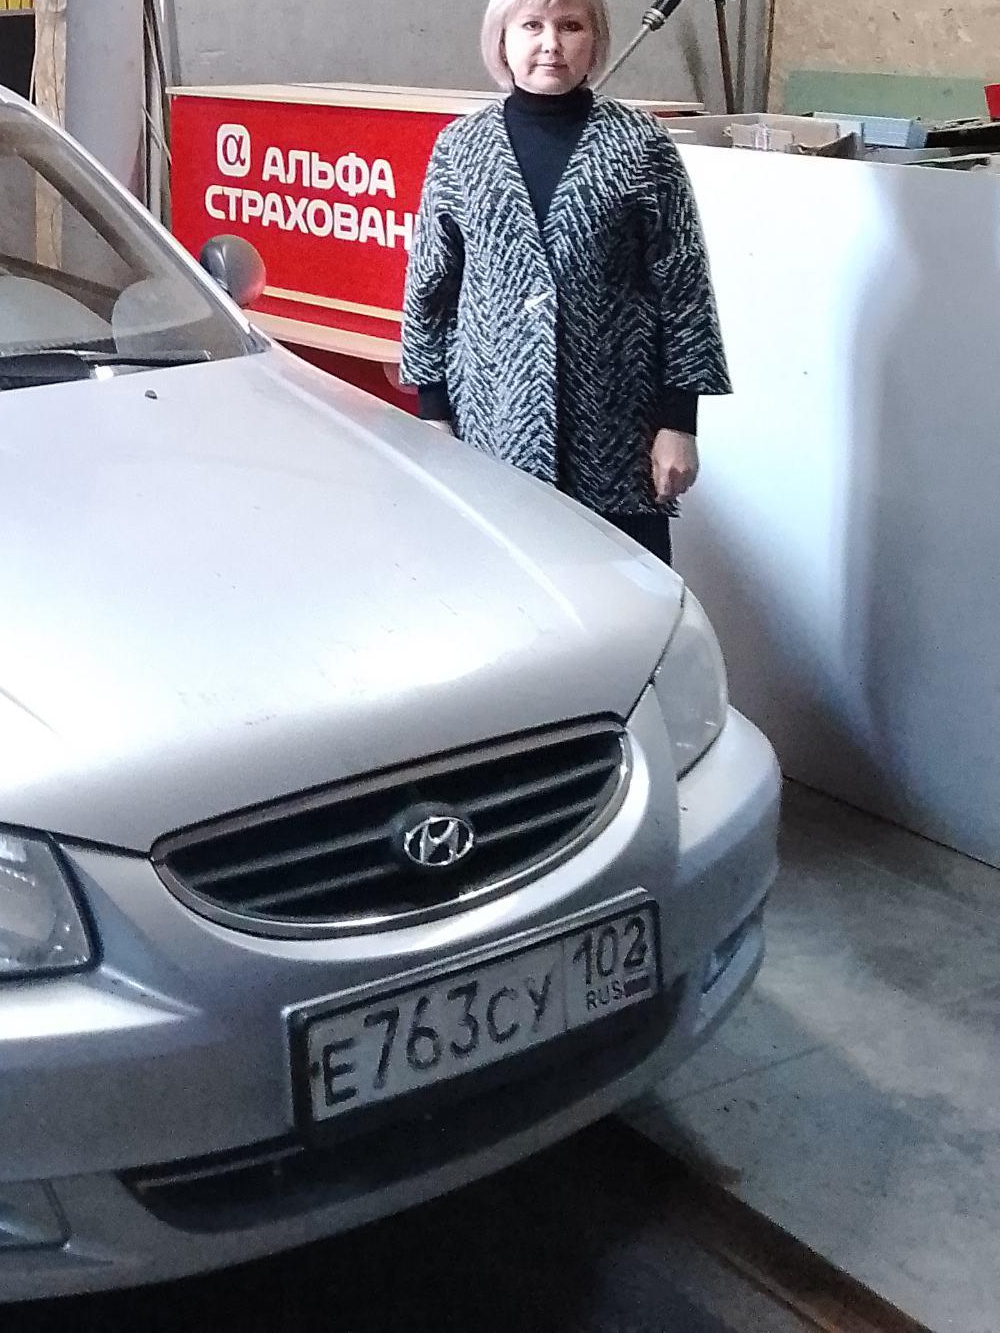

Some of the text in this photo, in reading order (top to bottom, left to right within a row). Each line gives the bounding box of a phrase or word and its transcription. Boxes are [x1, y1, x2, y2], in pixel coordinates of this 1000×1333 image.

[262, 147, 396, 198] АЛЬФА
[204, 185, 421, 251] СТРАХОВАН
[585, 980, 624, 1010] RUS
